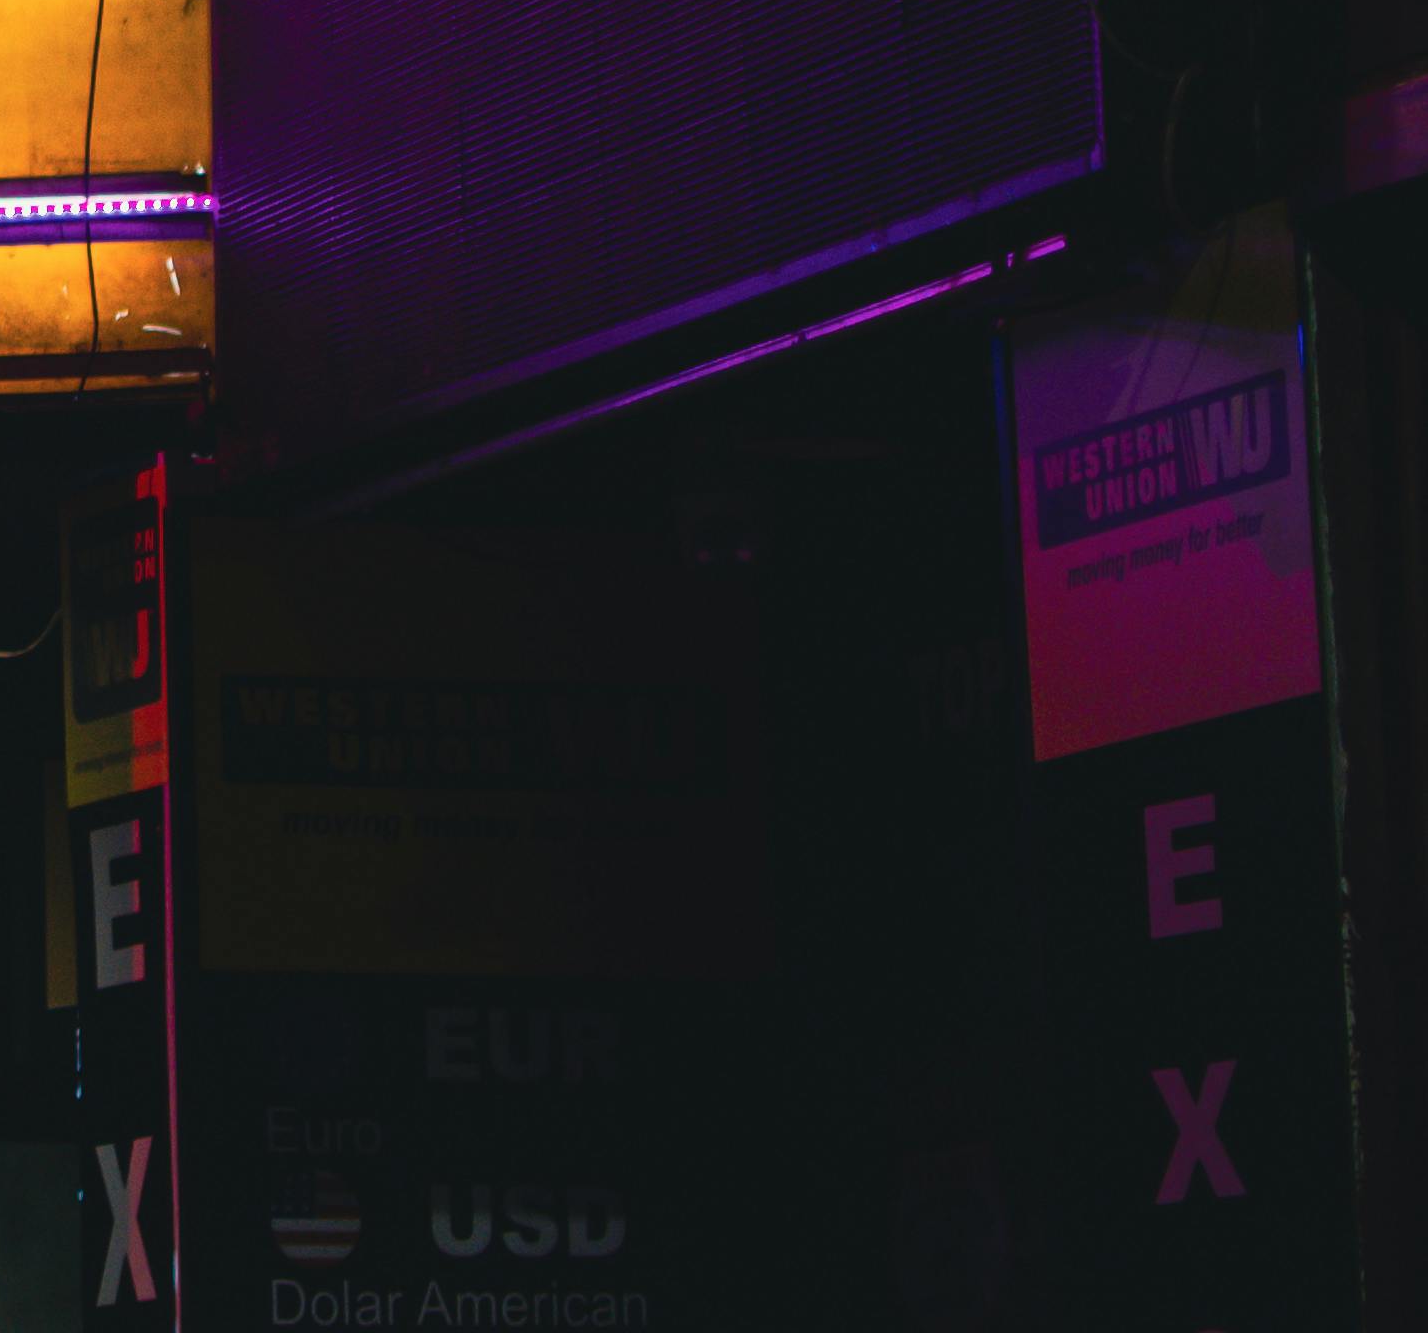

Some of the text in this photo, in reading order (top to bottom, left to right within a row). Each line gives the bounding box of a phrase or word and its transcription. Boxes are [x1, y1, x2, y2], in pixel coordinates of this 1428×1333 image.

[1042, 385, 1273, 489] WESTERN WU
[1085, 459, 1177, 520] UNION
[424, 1004, 623, 1083] EUR
[264, 1103, 383, 1156] Euro
[427, 1182, 628, 1260] USD
[270, 1276, 651, 1328] Dolar American
